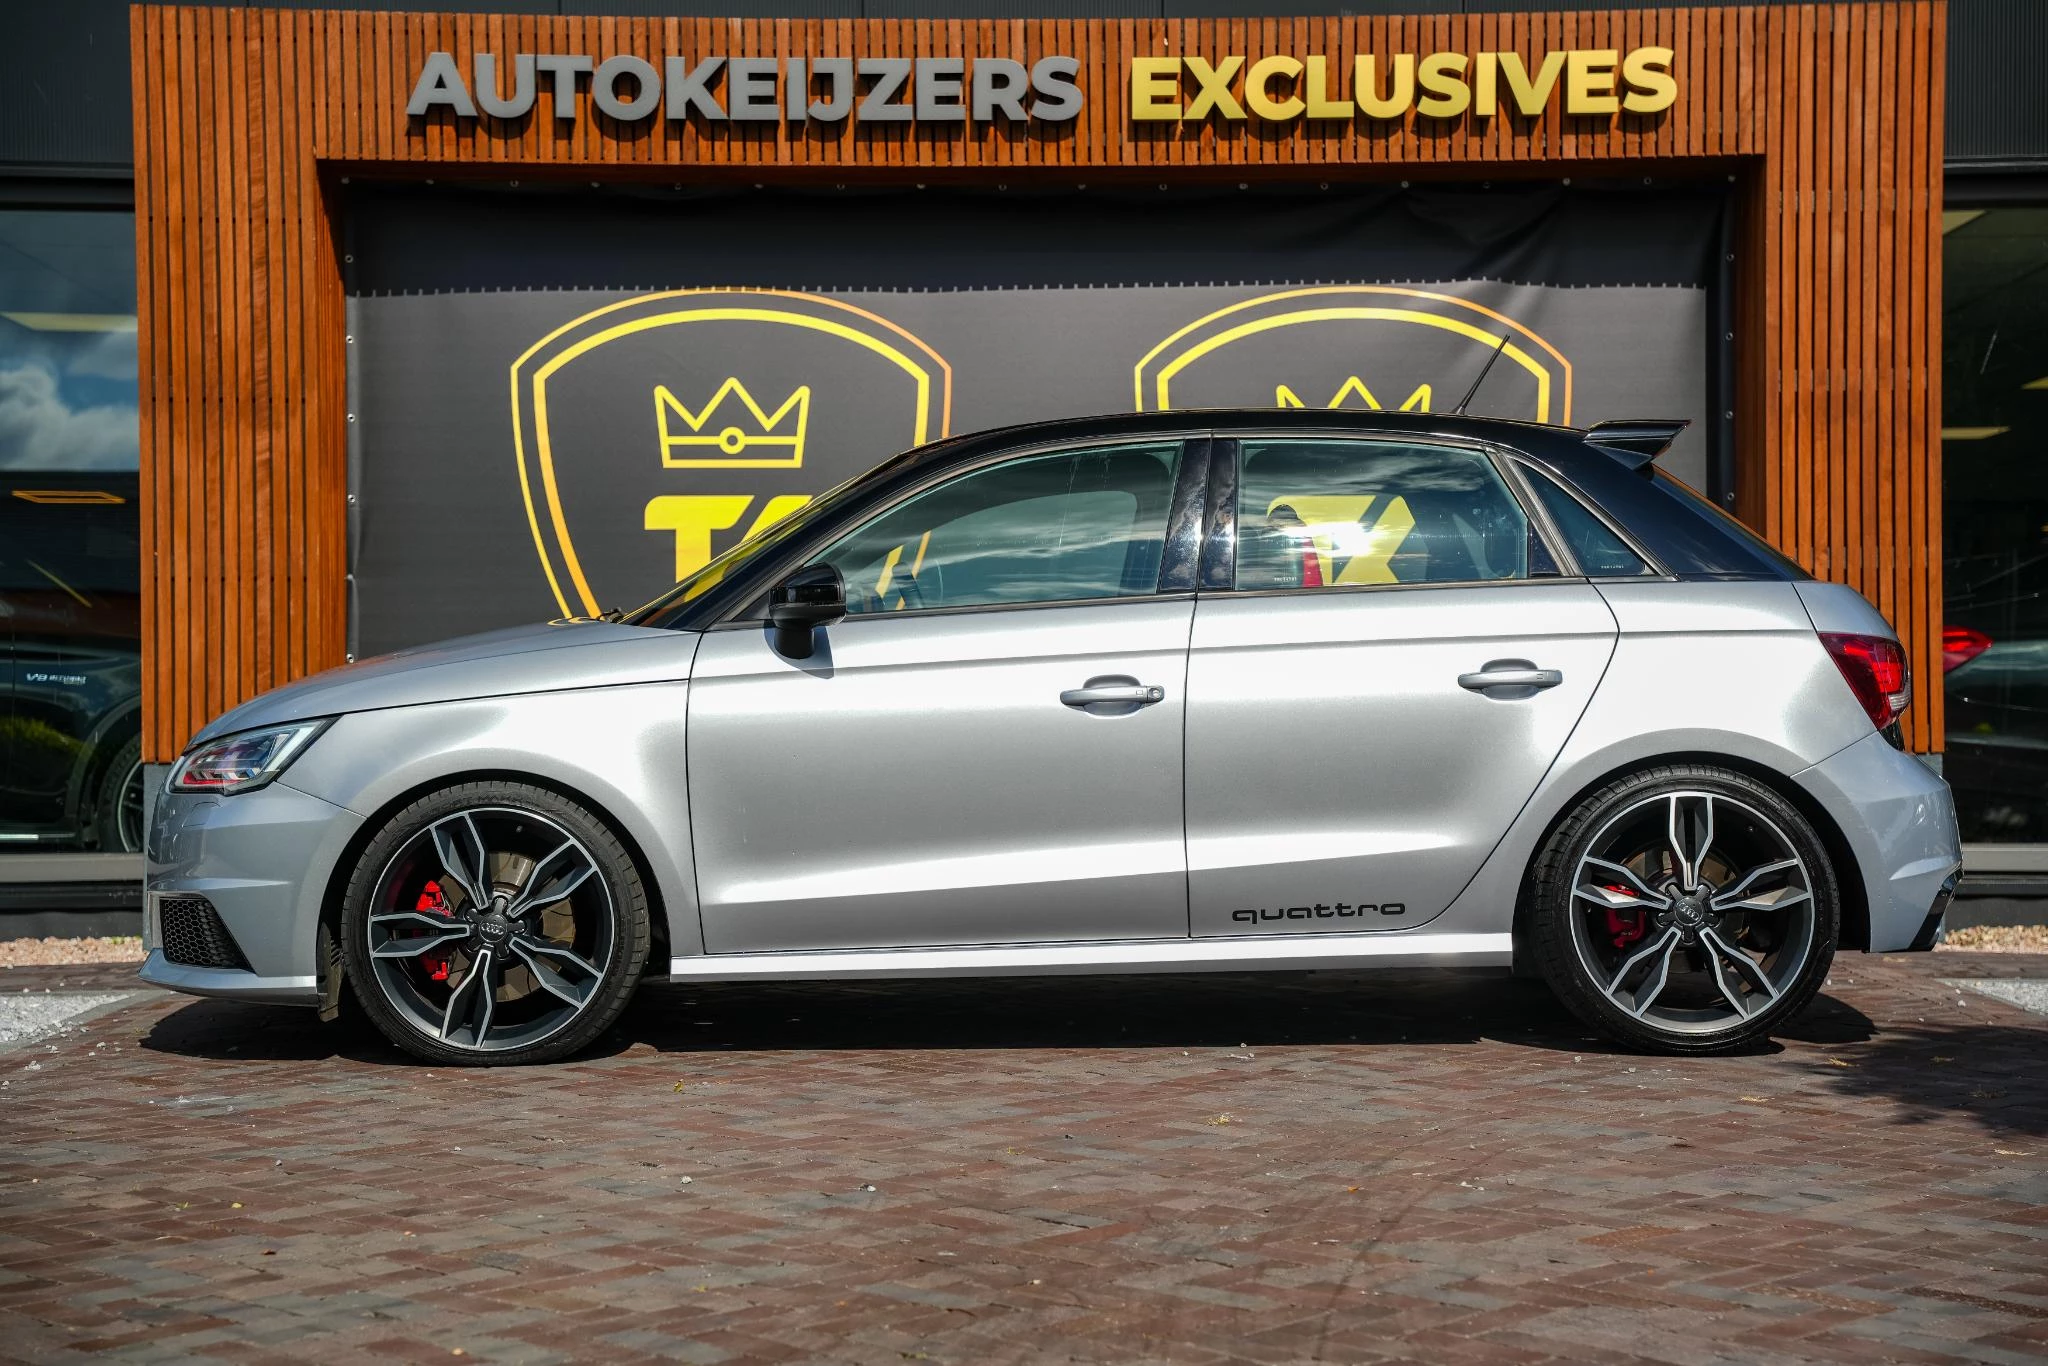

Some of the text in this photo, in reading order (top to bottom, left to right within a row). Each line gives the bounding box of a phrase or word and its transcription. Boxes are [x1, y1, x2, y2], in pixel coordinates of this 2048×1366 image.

[405, 46, 1679, 123] AUTOKEIJZERS EXCLUSIVES
[1231, 902, 1406, 925] quattro
